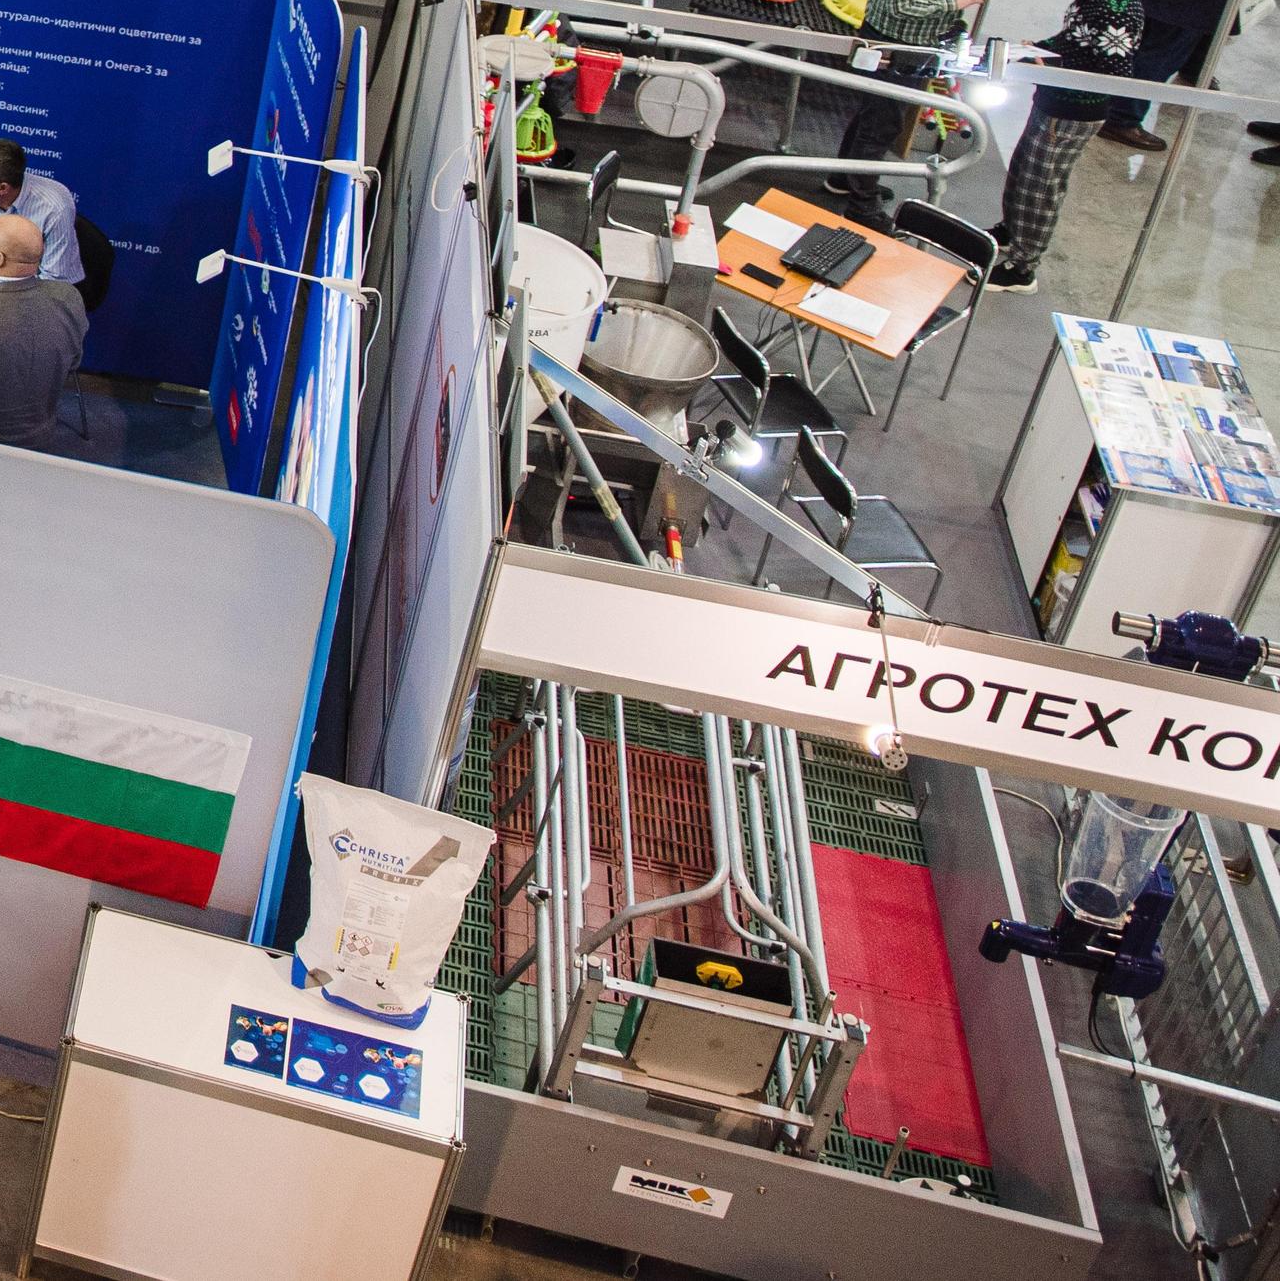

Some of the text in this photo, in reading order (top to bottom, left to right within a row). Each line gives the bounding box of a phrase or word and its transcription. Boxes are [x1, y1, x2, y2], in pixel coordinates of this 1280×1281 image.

[118, 26, 186, 44] оцветители
[188, 36, 202, 45] за
[0, 60, 30, 75] яйца;
[35, 50, 92, 67] минерали
[105, 59, 153, 75] Омега-3
[155, 68, 168, 77] за
[1, 122, 58, 139] продукти;
[765, 644, 1133, 749] АГРОТЕХ
[350, 842, 405, 867] CHRISTA
[362, 857, 403, 875] NUTRITION
[362, 866, 420, 886] PREMIX
[630, 1175, 689, 1195] MIK
